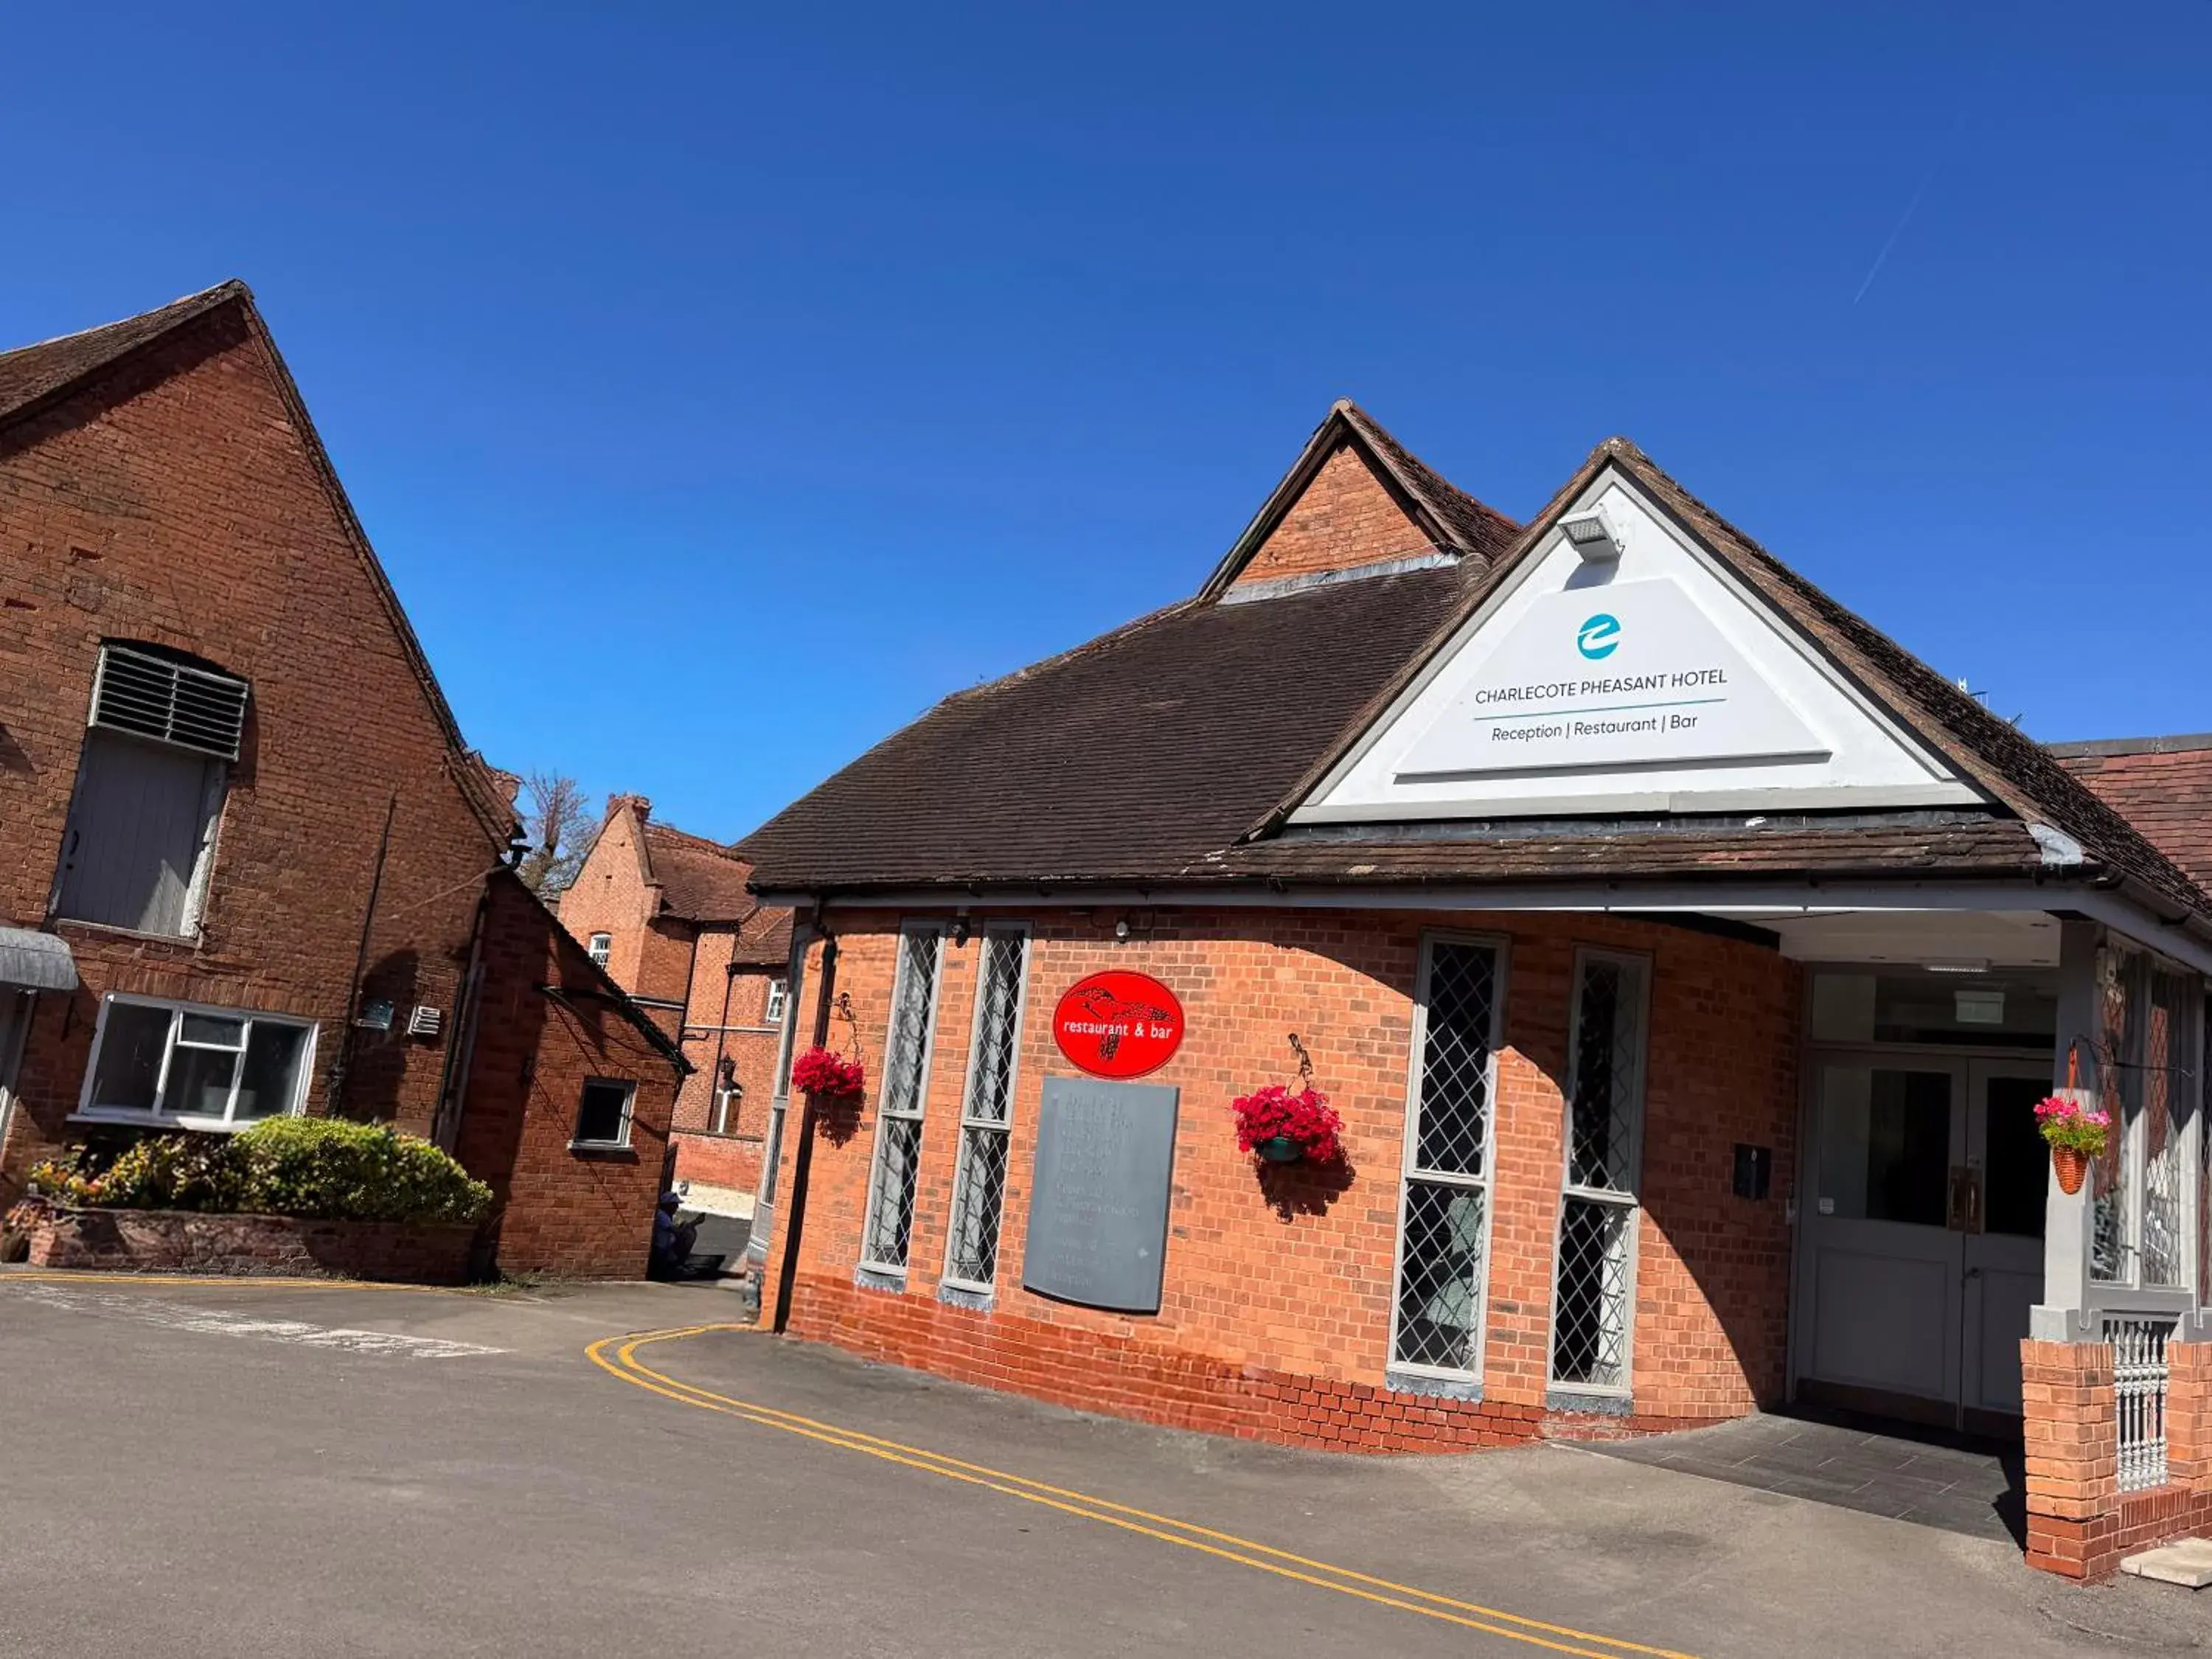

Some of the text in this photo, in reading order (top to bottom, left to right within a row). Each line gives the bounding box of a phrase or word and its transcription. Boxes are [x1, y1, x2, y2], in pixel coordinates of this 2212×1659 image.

[1475, 669, 1728, 704] CHARLECOTE PHEASANT HOTEL
[1492, 724, 1562, 742] Reception
[1574, 717, 1656, 736] Restaurant
[1670, 714, 1697, 729] Bar
[1063, 1021, 1172, 1039] restaurant & bar
